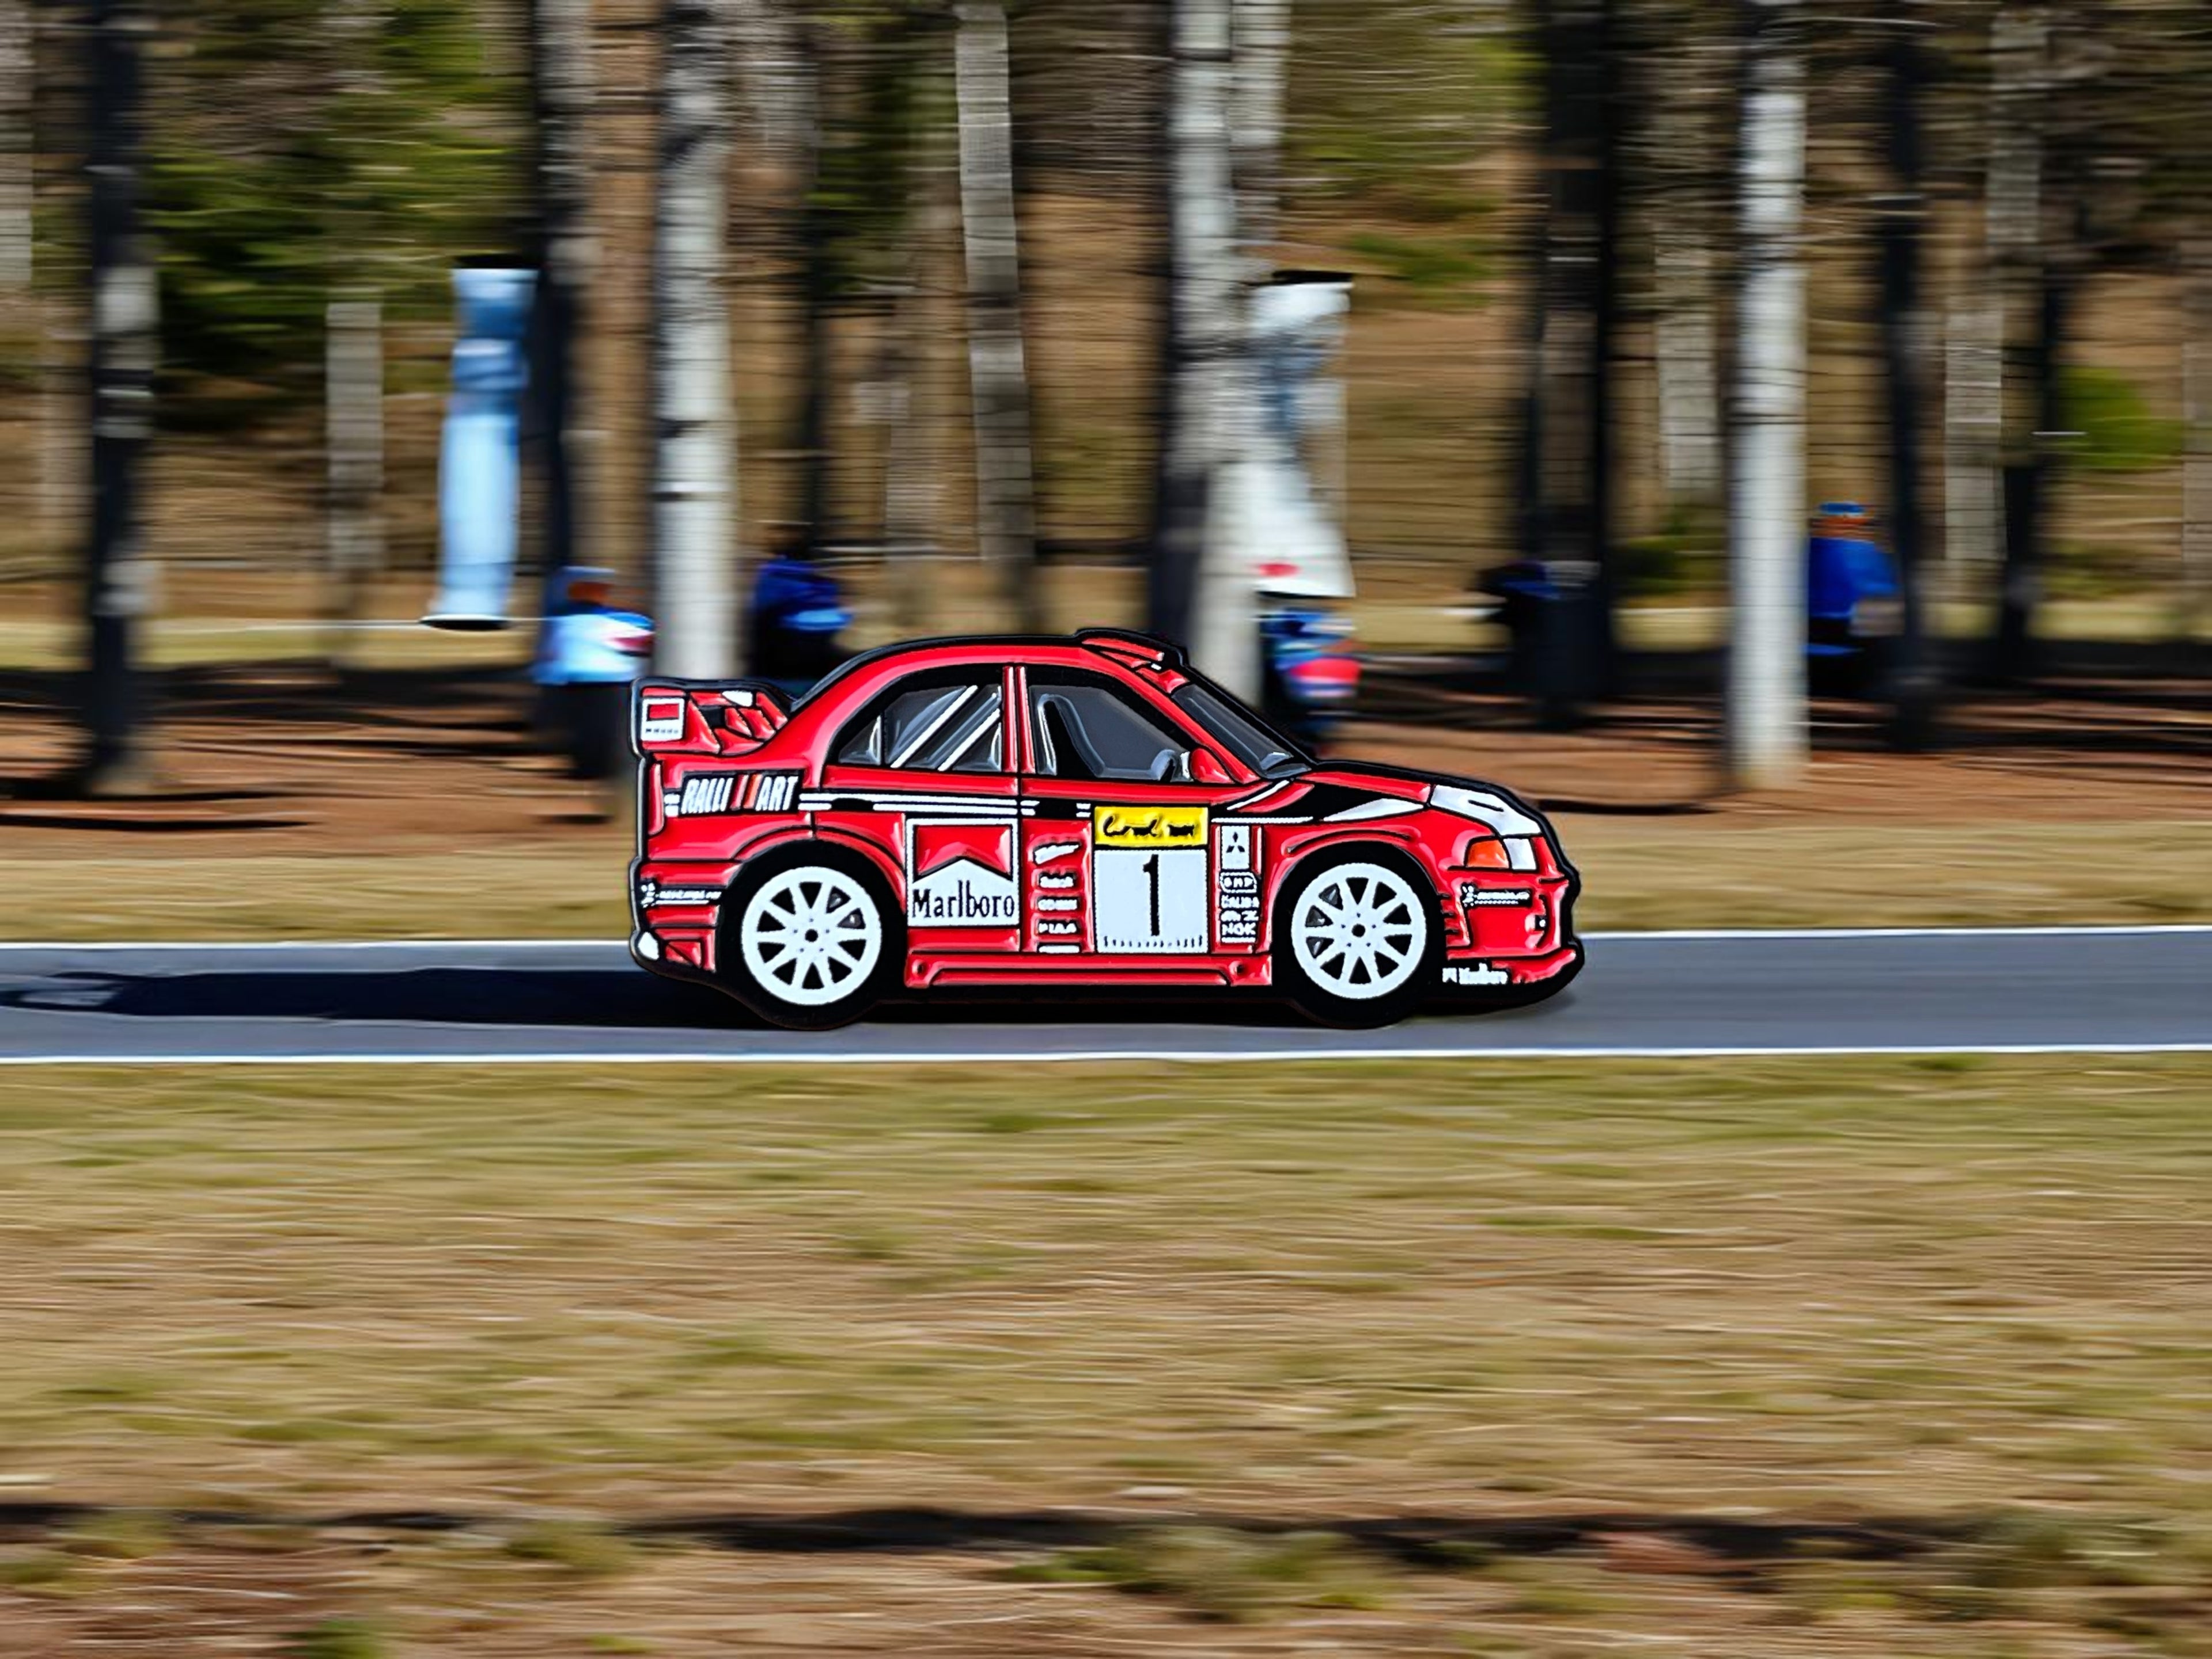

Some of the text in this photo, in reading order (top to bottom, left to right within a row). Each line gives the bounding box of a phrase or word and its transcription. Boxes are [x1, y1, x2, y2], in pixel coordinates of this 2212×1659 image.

[755, 776, 799, 811] ART
[912, 880, 1015, 918] Marlboro
[1143, 854, 1160, 937] 1
